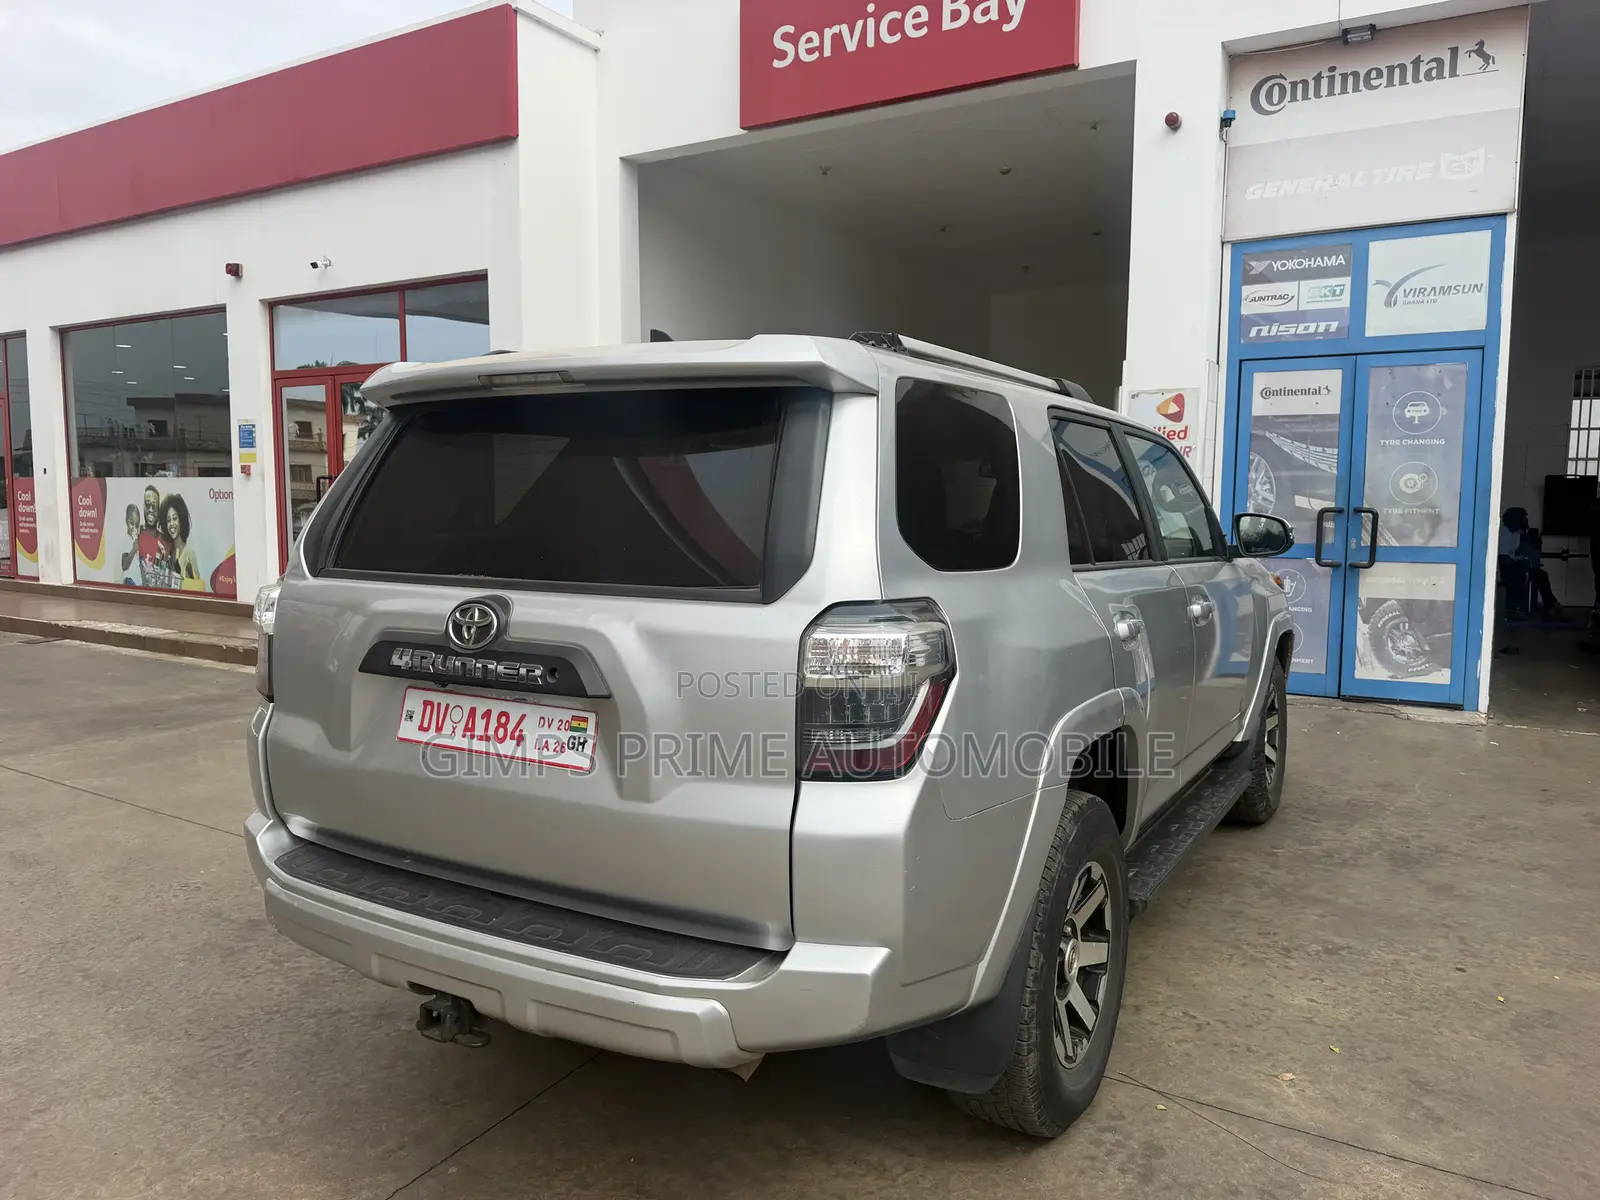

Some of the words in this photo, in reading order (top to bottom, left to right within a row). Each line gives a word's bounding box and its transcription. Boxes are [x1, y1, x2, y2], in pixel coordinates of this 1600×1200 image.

[772, 2, 929, 69] Service
[941, 0, 1027, 32] Bay
[1250, 45, 1461, 116] Continental
[1245, 170, 1364, 200] GENERAL
[1371, 161, 1437, 186] TIRE
[1272, 254, 1346, 271] YOKOHAMA
[1307, 284, 1345, 300] BKT
[1402, 283, 1484, 299] VIRAMSUN
[1260, 385, 1321, 400] Continental
[1402, 438, 1445, 446] CHANGING
[17, 490, 31, 501] Cool
[77, 494, 92, 506] Cool
[208, 487, 233, 503] Option
[79, 507, 98, 518] down!
[417, 699, 451, 735] DV
[461, 706, 527, 748] A184
[537, 715, 555, 730] DV
[556, 718, 571, 732] 20
[552, 740, 567, 754] 26
[566, 734, 588, 753] GH
